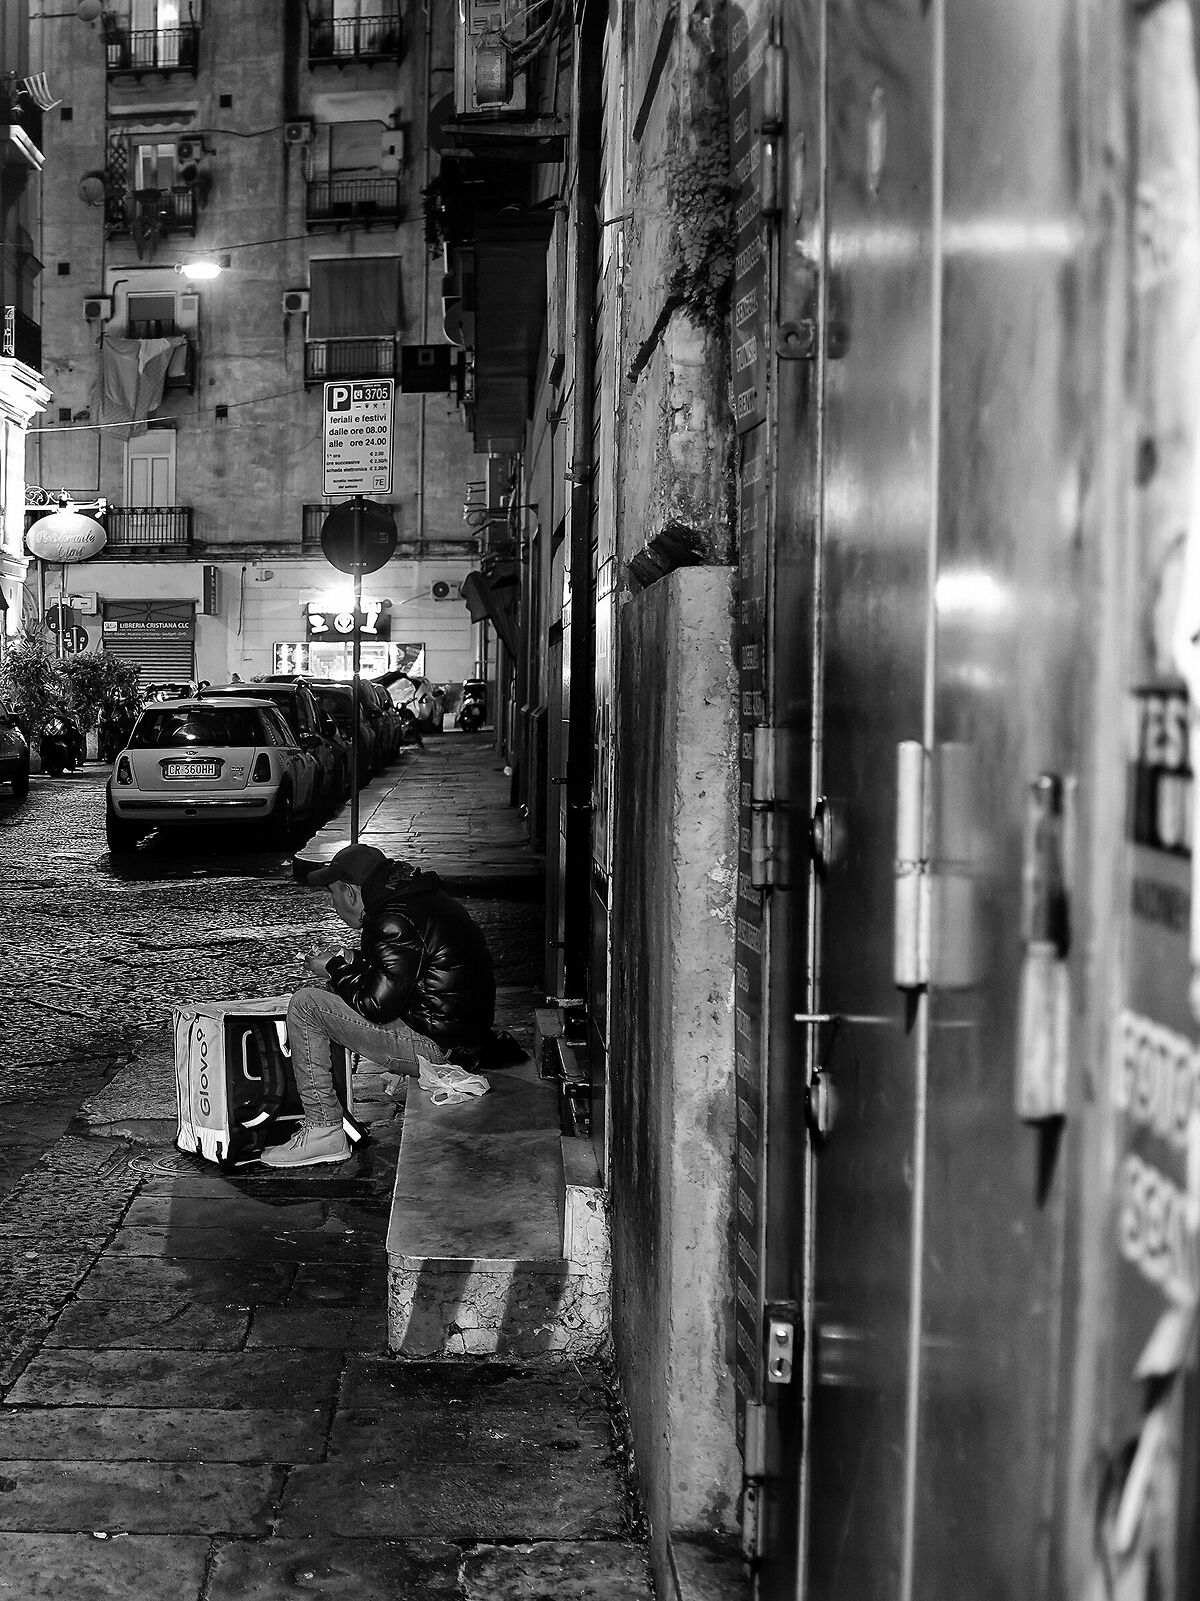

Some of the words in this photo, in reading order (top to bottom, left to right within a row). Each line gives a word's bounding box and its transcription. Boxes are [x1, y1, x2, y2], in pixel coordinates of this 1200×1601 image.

[333, 387, 349, 409] P
[365, 387, 388, 400] 3705
[330, 415, 353, 424] feriali
[362, 413, 387, 422] festivi
[329, 428, 349, 436] dalle
[350, 427, 364, 435] ore
[365, 425, 388, 434] 08.00
[329, 439, 344, 448] alle
[349, 439, 364, 447] ore
[365, 437, 387, 446] 24.00
[169, 764, 181, 775] CR
[184, 764, 215, 775] 360HH
[199, 1040, 211, 1117] Glovo
